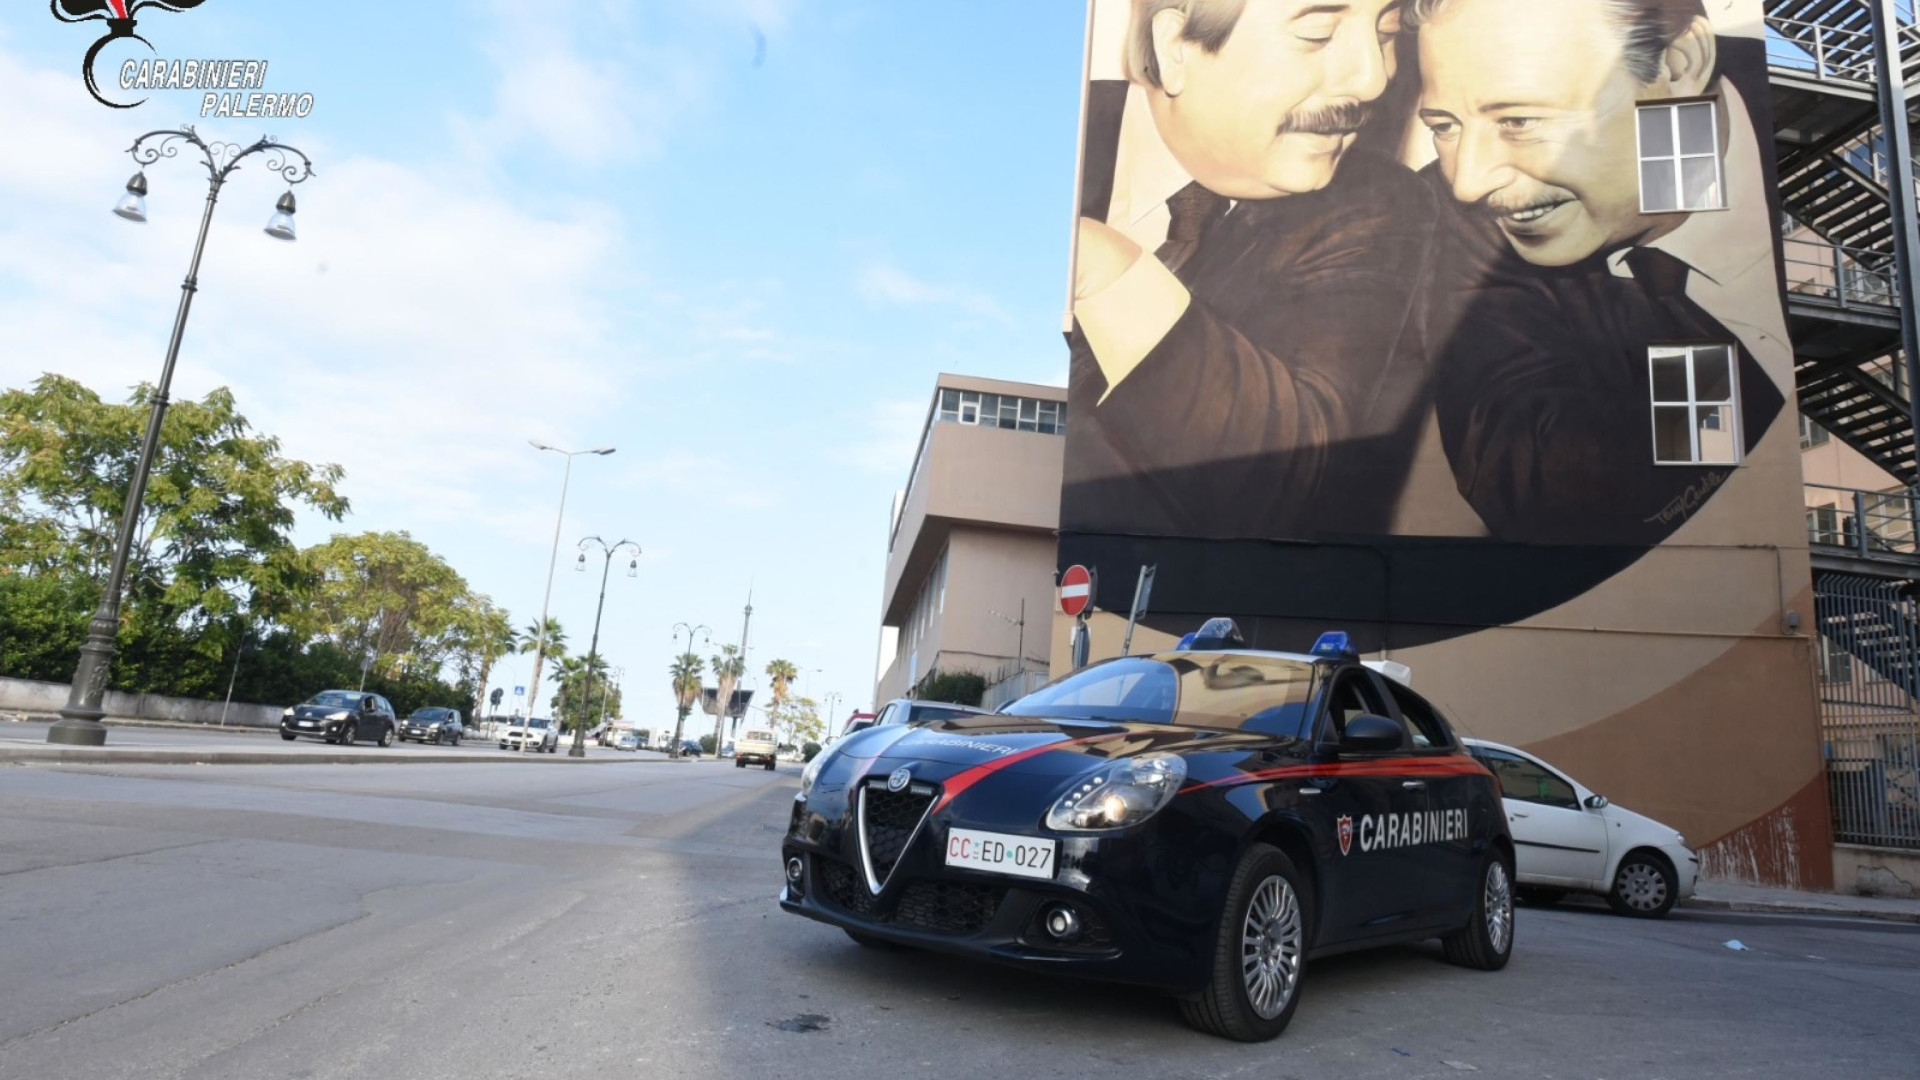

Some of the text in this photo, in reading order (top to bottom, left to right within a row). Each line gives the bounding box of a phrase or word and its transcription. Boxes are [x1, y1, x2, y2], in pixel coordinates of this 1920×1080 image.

[898, 737, 1018, 755] CARABINIERI
[1360, 808, 1468, 852] CARABINIERI
[949, 836, 1051, 869] CC ED 027
